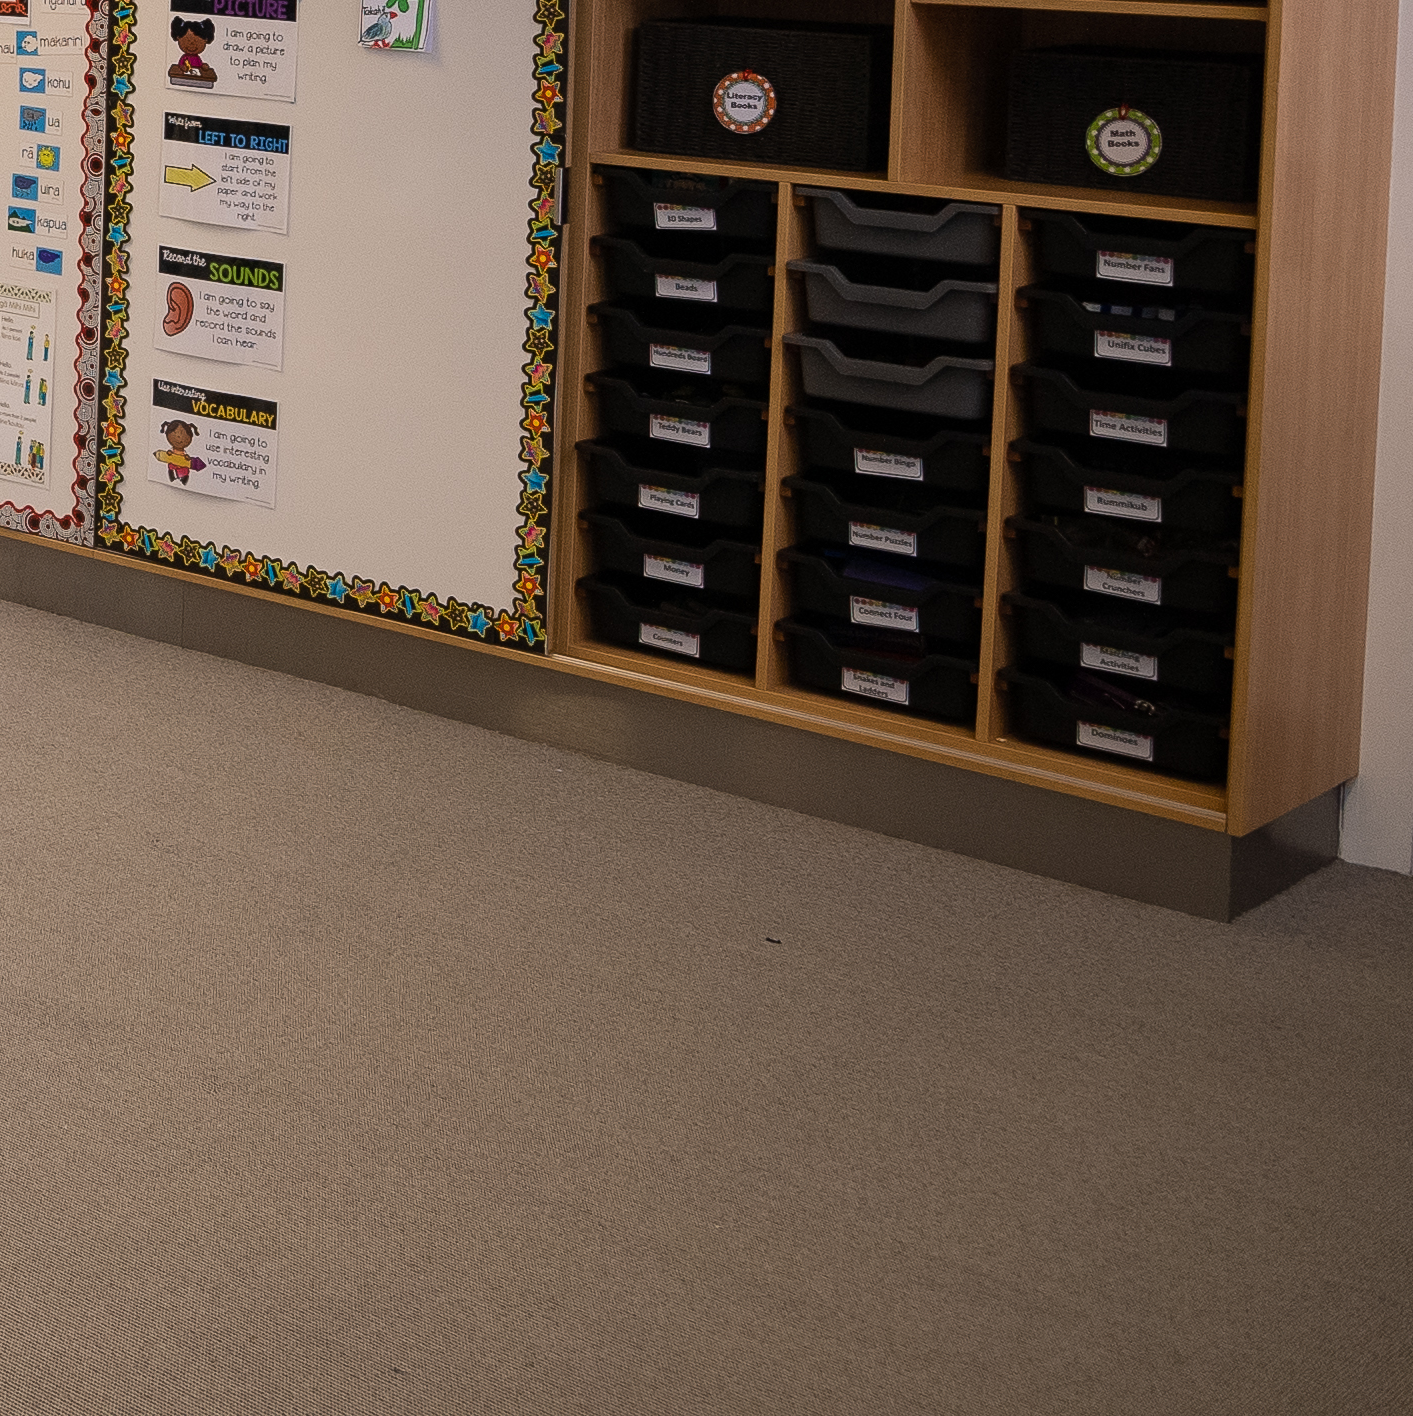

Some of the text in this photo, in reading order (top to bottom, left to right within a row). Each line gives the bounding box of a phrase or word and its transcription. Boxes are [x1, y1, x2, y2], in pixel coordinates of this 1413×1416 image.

[40, 36, 82, 48] makariri
[47, 76, 70, 89] kohu
[727, 92, 763, 102] Literacy
[730, 101, 757, 110] Books
[199, 130, 288, 153] LEFT TO RIGHT
[1110, 130, 1135, 138] Math
[1108, 140, 1140, 148] Books
[40, 185, 59, 196] uira
[37, 215, 67, 233] kapua
[12, 247, 34, 260] huka
[1103, 259, 1165, 274] Number Fans
[209, 262, 279, 289] SOUNDS
[1107, 340, 1166, 355] Unifix Cubes
[191, 399, 274, 427] VOCABULARY
[658, 422, 702, 437] Teddy Bears
[1093, 420, 1163, 437] Time Activities
[650, 495, 695, 509] Playing Cards
[1097, 496, 1147, 512] Rummikub
[664, 564, 690, 577] Money
[859, 606, 913, 622] Connect Four
[1091, 728, 1138, 746] Dominoes
